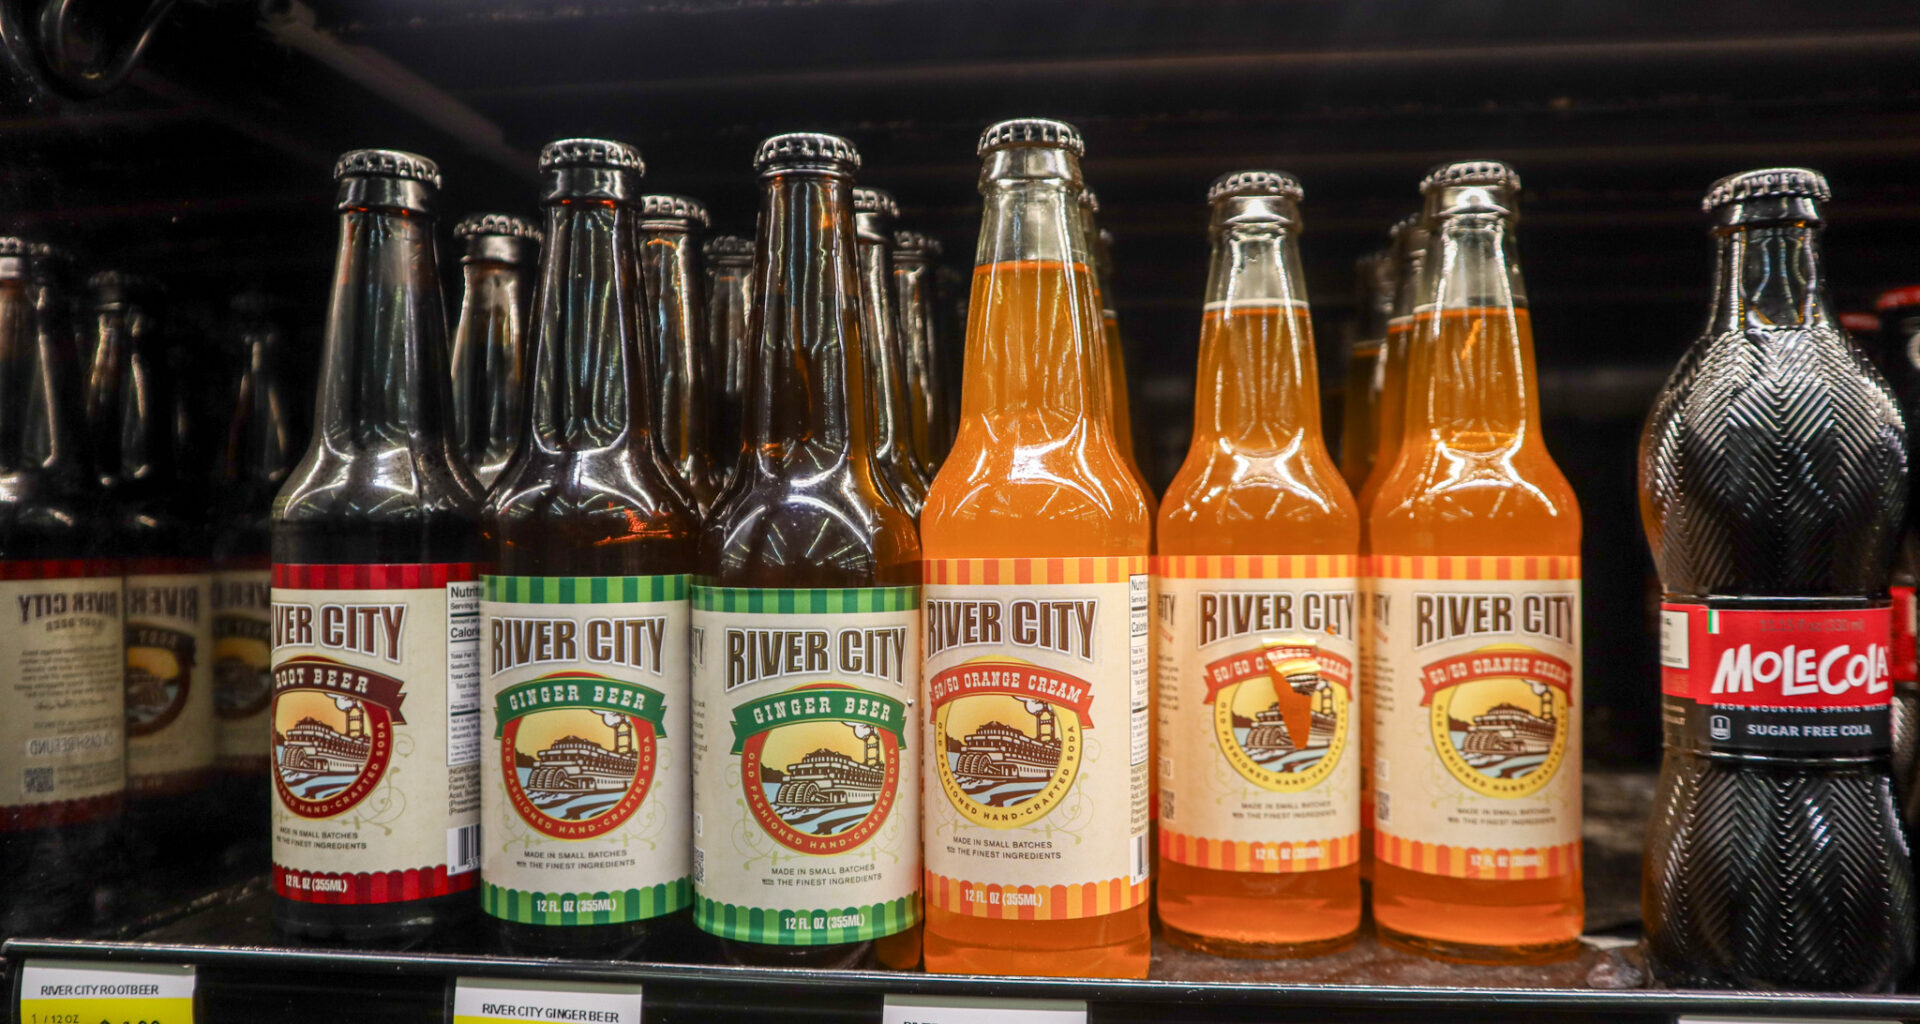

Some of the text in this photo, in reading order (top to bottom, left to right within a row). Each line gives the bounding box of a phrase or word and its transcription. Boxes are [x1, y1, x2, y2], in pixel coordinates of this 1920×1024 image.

[1198, 592, 1294, 649] RIVER
[1301, 591, 1355, 645] CITY
[1414, 592, 1515, 649] RIVER
[1522, 592, 1575, 646] CITY
[272, 603, 407, 664] VER CITY
[927, 599, 1098, 663] RIVER CITY
[490, 616, 667, 678] RIVER CITY
[725, 626, 907, 693] RIVER CITY
[1472, 657, 1529, 674] ORANGE
[314, 669, 369, 694] BEER
[963, 671, 1020, 688] ORANGE
[1028, 674, 1082, 704] CREAM
[509, 684, 646, 710] GINGER BEER
[753, 696, 891, 724] GINGER BEER
[1713, 702, 1746, 711] FROM
[1750, 704, 1817, 714] MOUNTAIN
[1821, 704, 1861, 714] SPRING
[1747, 724, 1872, 736] SUGAR FREE COLA
[299, 722, 386, 813] HAND-CRAFTED SODA
[939, 754, 977, 815] FASHIONED
[983, 768, 1069, 821] HAND-CRAFTED
[1067, 725, 1075, 761] SODA
[507, 770, 553, 829] FASHIONED
[558, 778, 646, 834] HAND-CRAFTED
[642, 736, 651, 771] SODA
[750, 785, 802, 845] FASHIONED
[810, 791, 891, 849] HAND-CRAFTED
[887, 748, 896, 783] SODA
[314, 842, 367, 850] INGREDIENTS
[321, 832, 359, 840] BATCHES
[953, 836, 971, 845] MADE
[983, 839, 1010, 849] SMALL
[1012, 841, 1053, 849] BATCHES
[524, 851, 544, 859] MADE
[558, 851, 585, 859] SMALL
[588, 849, 628, 859] BATCHES
[957, 847, 1061, 860] THE FINEST INGREDIENTS
[529, 859, 635, 870] THE FINEST INGREDIENTS
[839, 863, 875, 874] BATCHES
[285, 874, 347, 894] 12 FL. OZ (355ML)
[829, 873, 882, 885] INGREDIENTS
[536, 898, 617, 913] 12 FL. OZ (355ML)
[965, 889, 1042, 907] 12 FL. OZ (355ML)
[785, 913, 865, 930] 12 FL. OZ (355ML)
[40, 984, 159, 995] RIVER CITY ROOTBEER
[482, 1003, 619, 1023] RIVER CITY GINGER BEER
